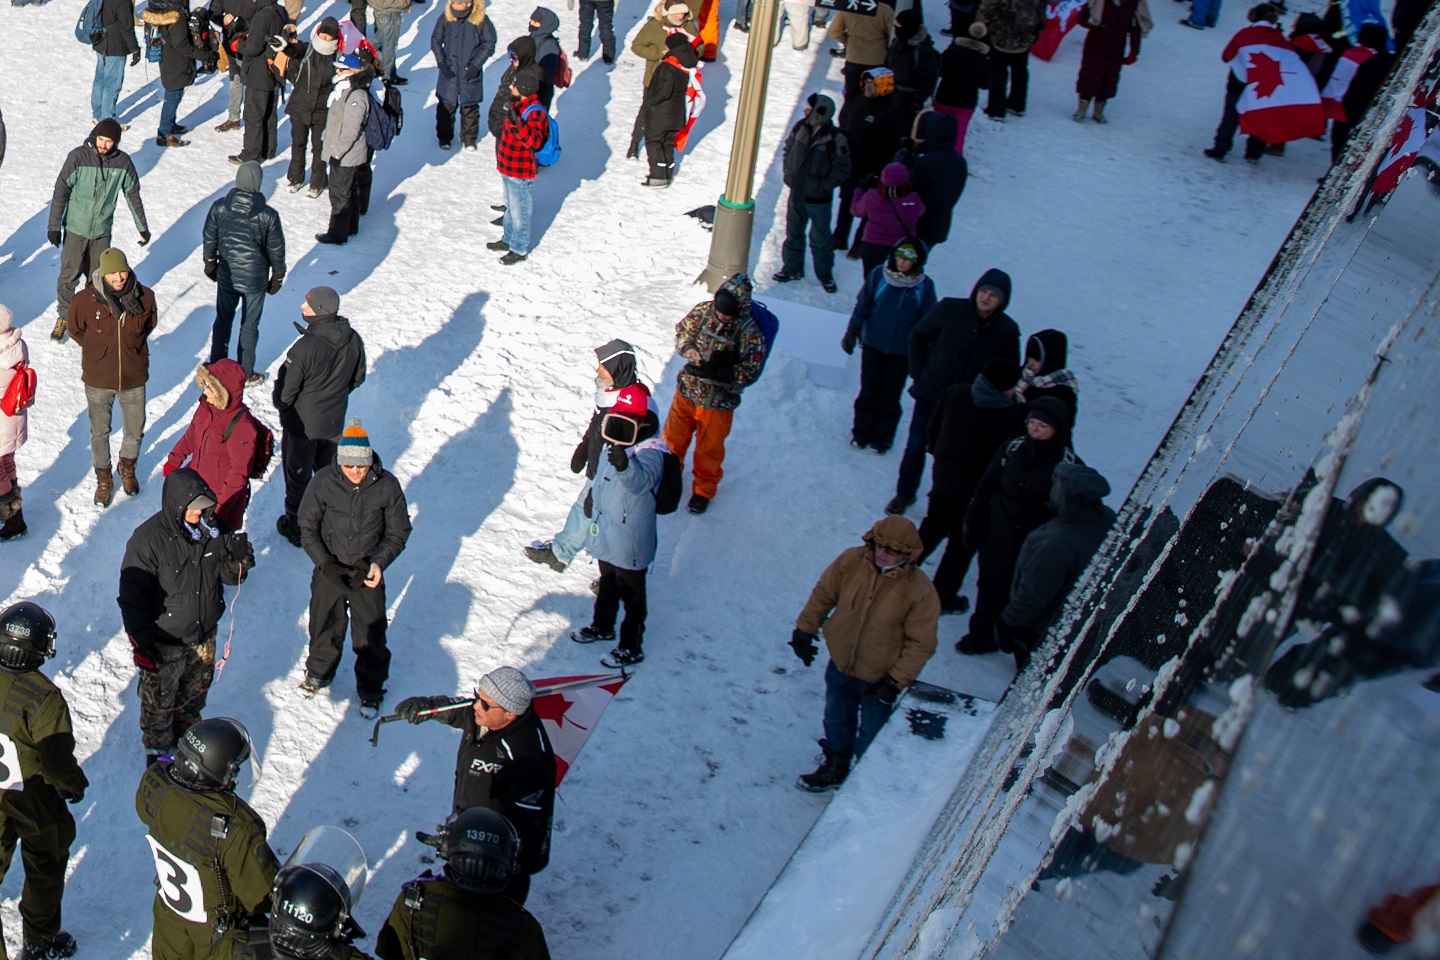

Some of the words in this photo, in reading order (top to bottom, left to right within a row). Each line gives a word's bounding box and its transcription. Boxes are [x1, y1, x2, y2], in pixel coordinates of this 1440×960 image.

[5, 623, 31, 637] 13738
[470, 758, 503, 774] FXR
[466, 829, 500, 844] 13970
[156, 847, 193, 913] 3
[283, 900, 314, 924] 11120
